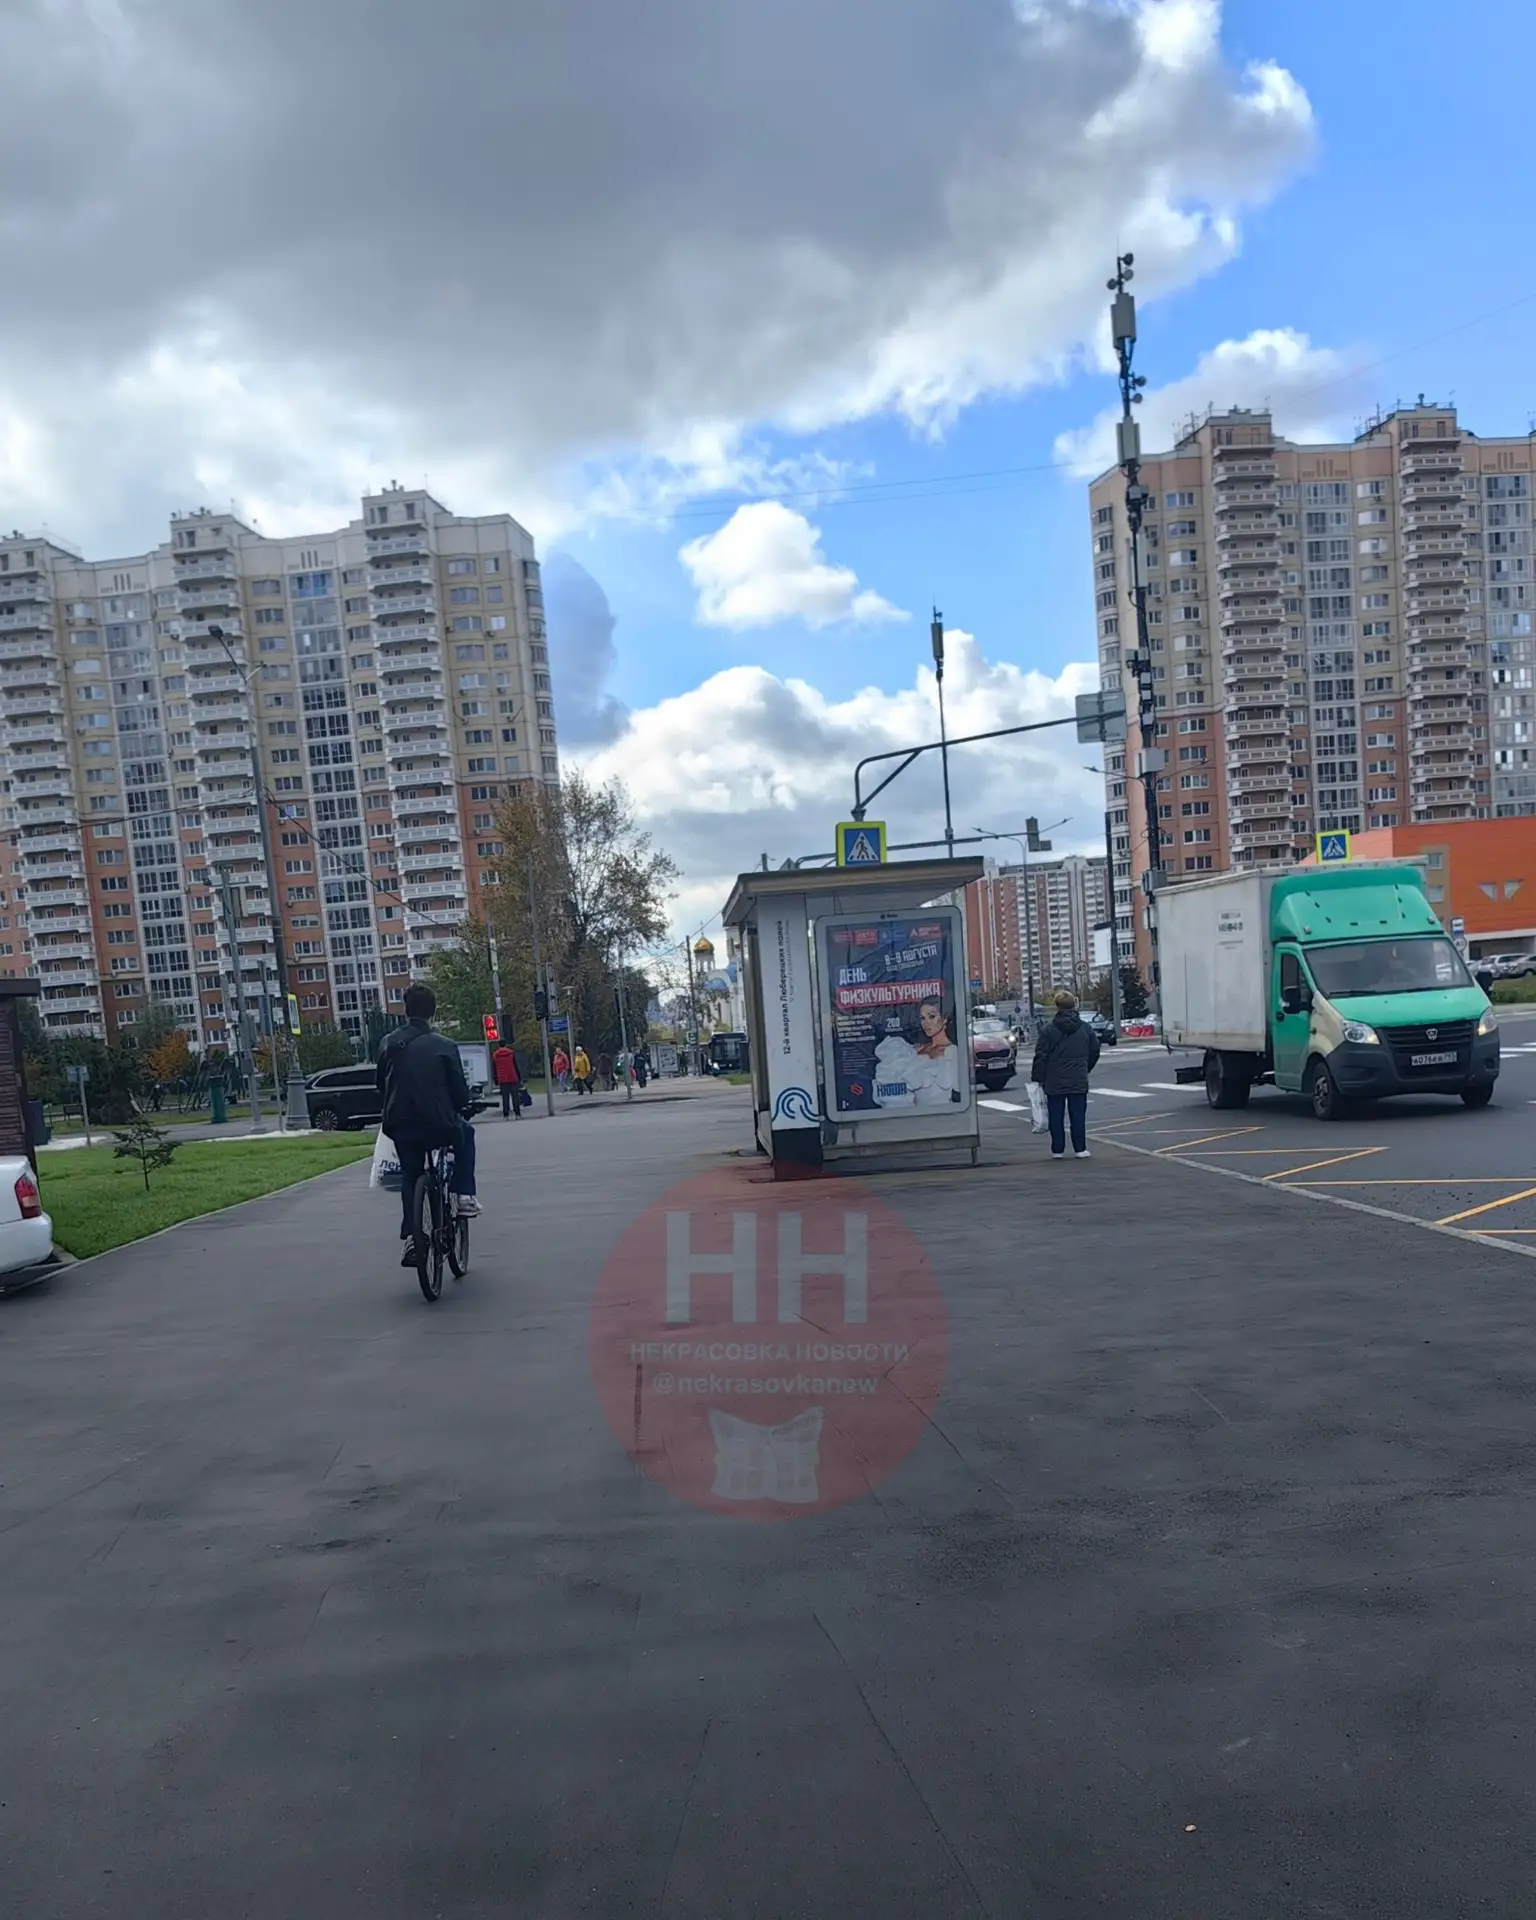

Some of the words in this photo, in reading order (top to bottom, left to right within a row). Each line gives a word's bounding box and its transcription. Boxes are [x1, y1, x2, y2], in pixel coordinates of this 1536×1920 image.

[902, 944, 938, 962] АВГУСТА
[779, 948, 788, 1003] Люберецких
[839, 967, 867, 986] ДЕНЬ
[1077, 964, 1087, 972] 40
[840, 981, 940, 1005] ФИЗКУЛЬТУРНИКА
[781, 1004, 790, 1037] квартал
[886, 1017, 900, 1028] 200
